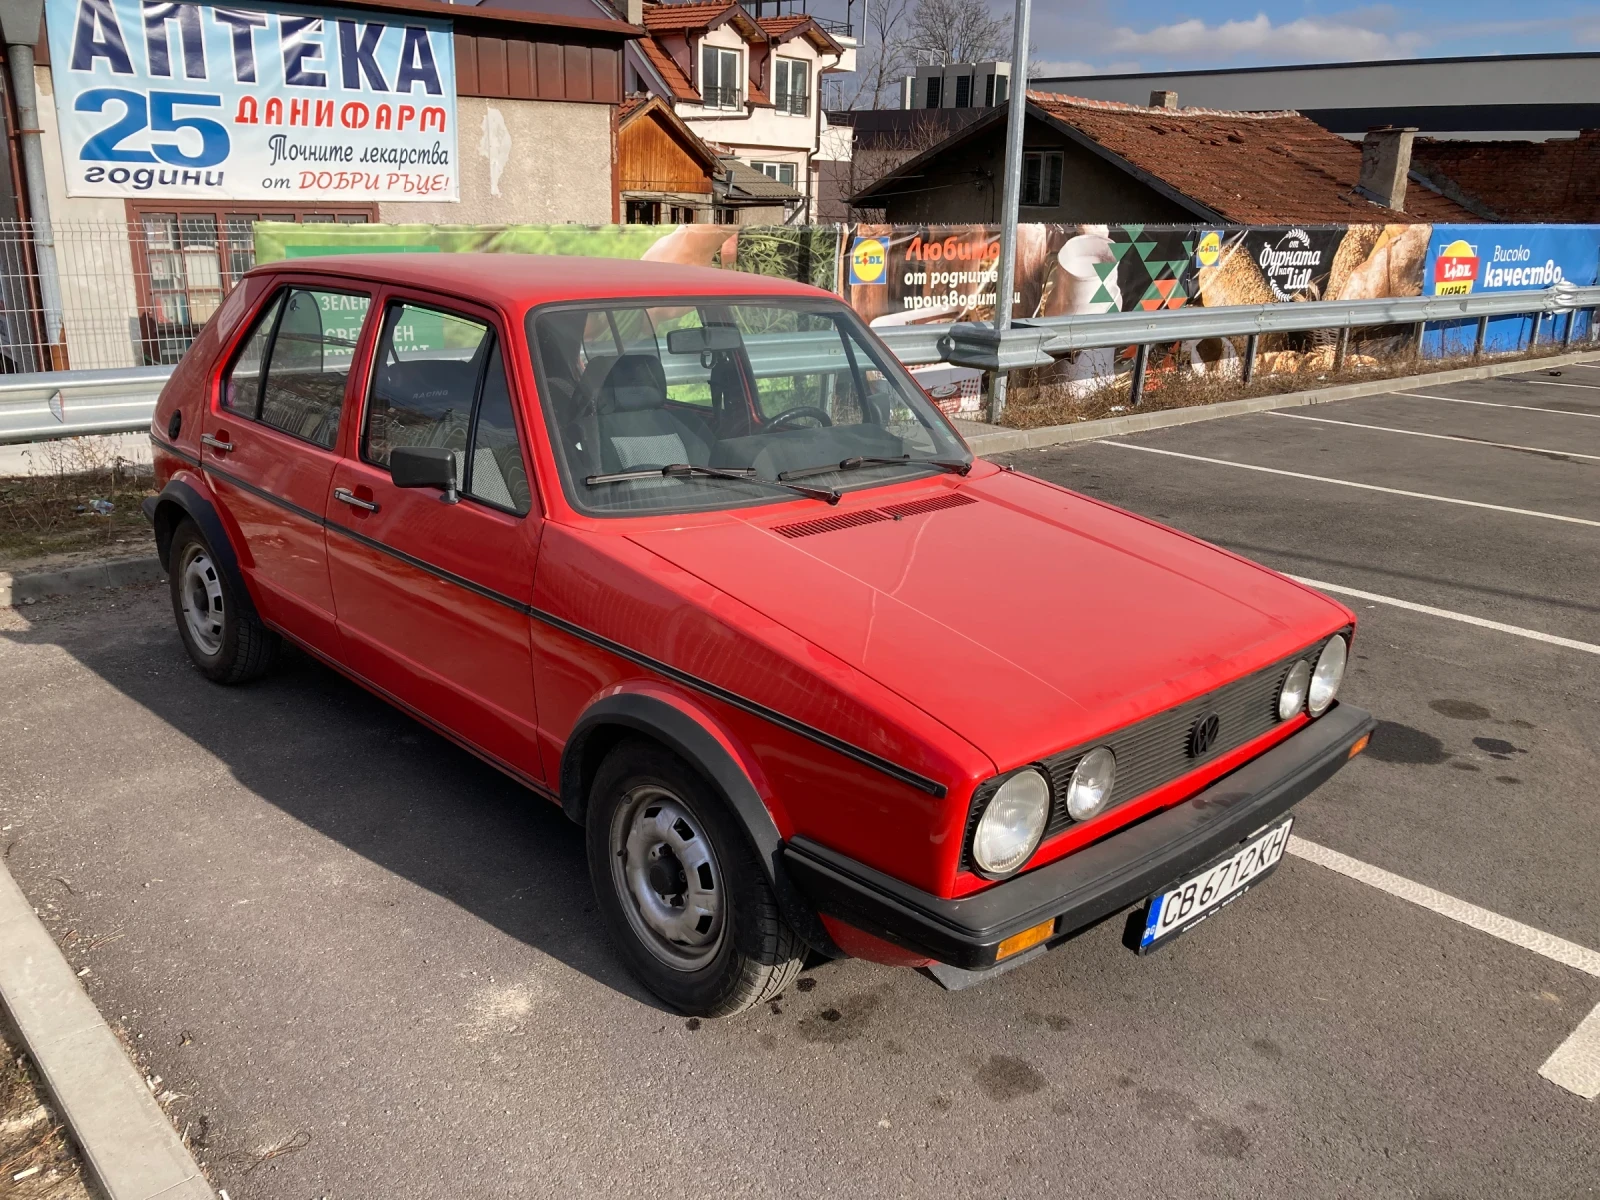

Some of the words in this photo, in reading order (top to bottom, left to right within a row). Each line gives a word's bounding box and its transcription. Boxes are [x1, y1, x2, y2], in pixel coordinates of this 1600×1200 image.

[69, 0, 444, 97] АПТЕКА
[234, 95, 447, 133] ДАНИФАРМ
[74, 88, 231, 168] 25
[268, 134, 354, 166] Точните
[359, 140, 449, 170] лекарства
[84, 166, 224, 190] години
[261, 177, 291, 189] от
[298, 171, 380, 190] ДОБРИ
[386, 172, 449, 195] РЪЦЕ!
[1289, 240, 1299, 248] от
[1493, 245, 1530, 262] Високо
[1259, 242, 1321, 277] Фурната
[904, 272, 926, 285] от
[931, 270, 998, 289] родните
[1284, 267, 1312, 290] Lidl
[903, 290, 1021, 312] производити
[413, 390, 448, 399] RACING
[1144, 924, 1157, 939] BG
